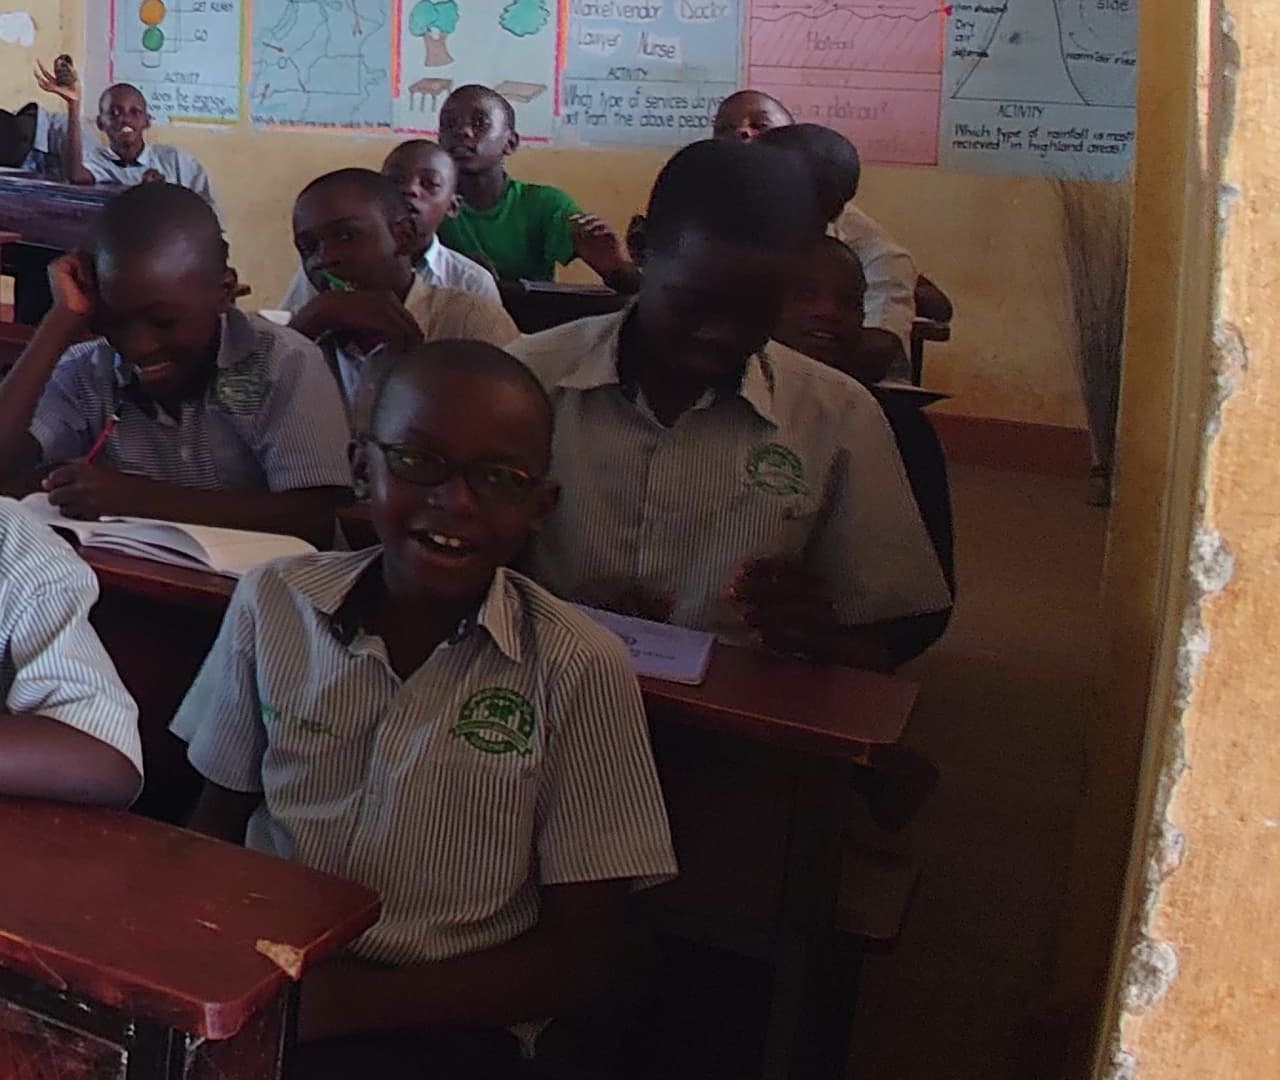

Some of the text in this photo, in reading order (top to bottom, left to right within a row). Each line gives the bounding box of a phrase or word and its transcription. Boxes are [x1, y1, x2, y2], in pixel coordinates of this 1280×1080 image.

[640, 31, 676, 59] Nurse
[998, 105, 1044, 119] ACTIVITY
[954, 123, 991, 138] Which
[996, 126, 1021, 145] type
[1047, 126, 1089, 141] rainfall
[1028, 138, 1083, 159] highland
